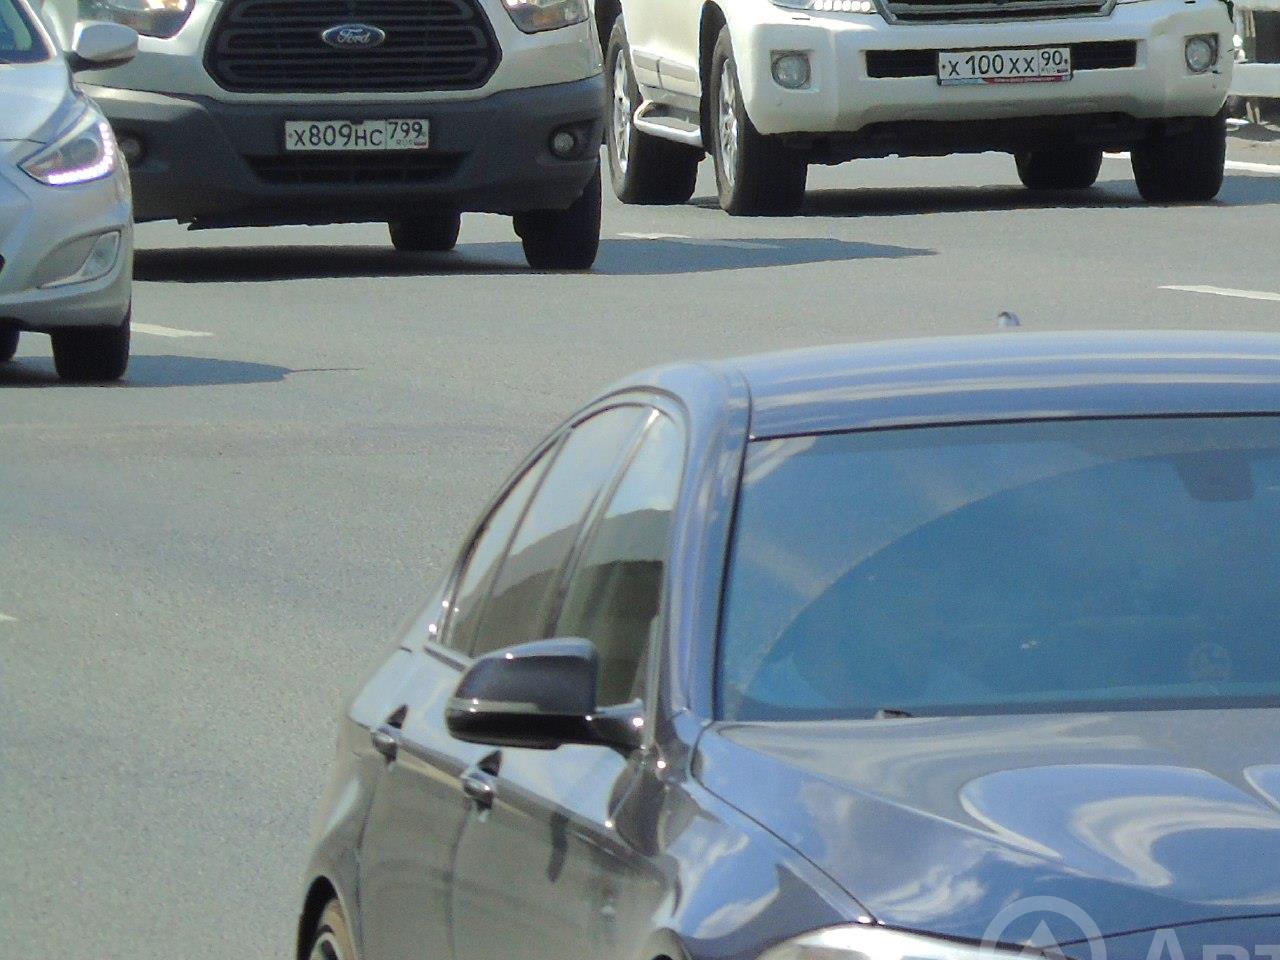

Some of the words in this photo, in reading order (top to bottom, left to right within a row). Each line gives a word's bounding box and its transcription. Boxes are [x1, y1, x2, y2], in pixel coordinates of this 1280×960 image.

[337, 28, 371, 44] Ford
[948, 54, 1035, 76] Х100ХХ
[1041, 50, 1063, 66] 90
[294, 124, 383, 147] Х809НС
[388, 121, 423, 139] 799
